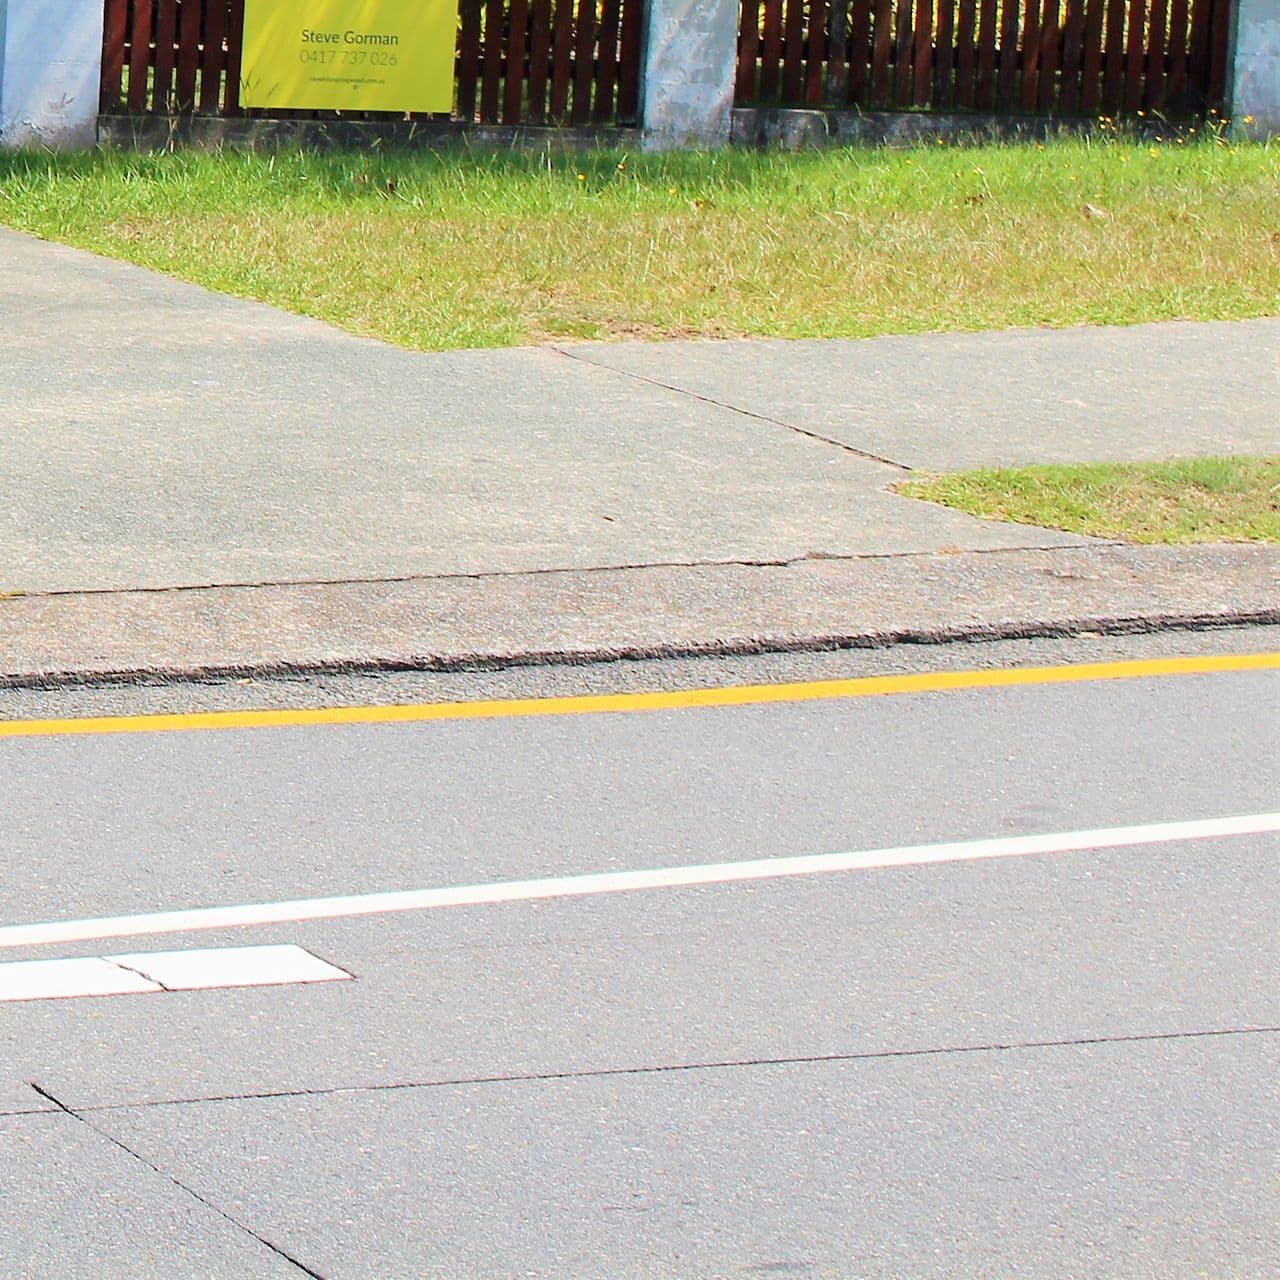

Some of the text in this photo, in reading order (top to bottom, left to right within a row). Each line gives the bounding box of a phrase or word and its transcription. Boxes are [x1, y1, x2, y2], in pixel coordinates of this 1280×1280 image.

[301, 29, 400, 46] Steve Gorman
[299, 49, 398, 67] 0417 737 026
